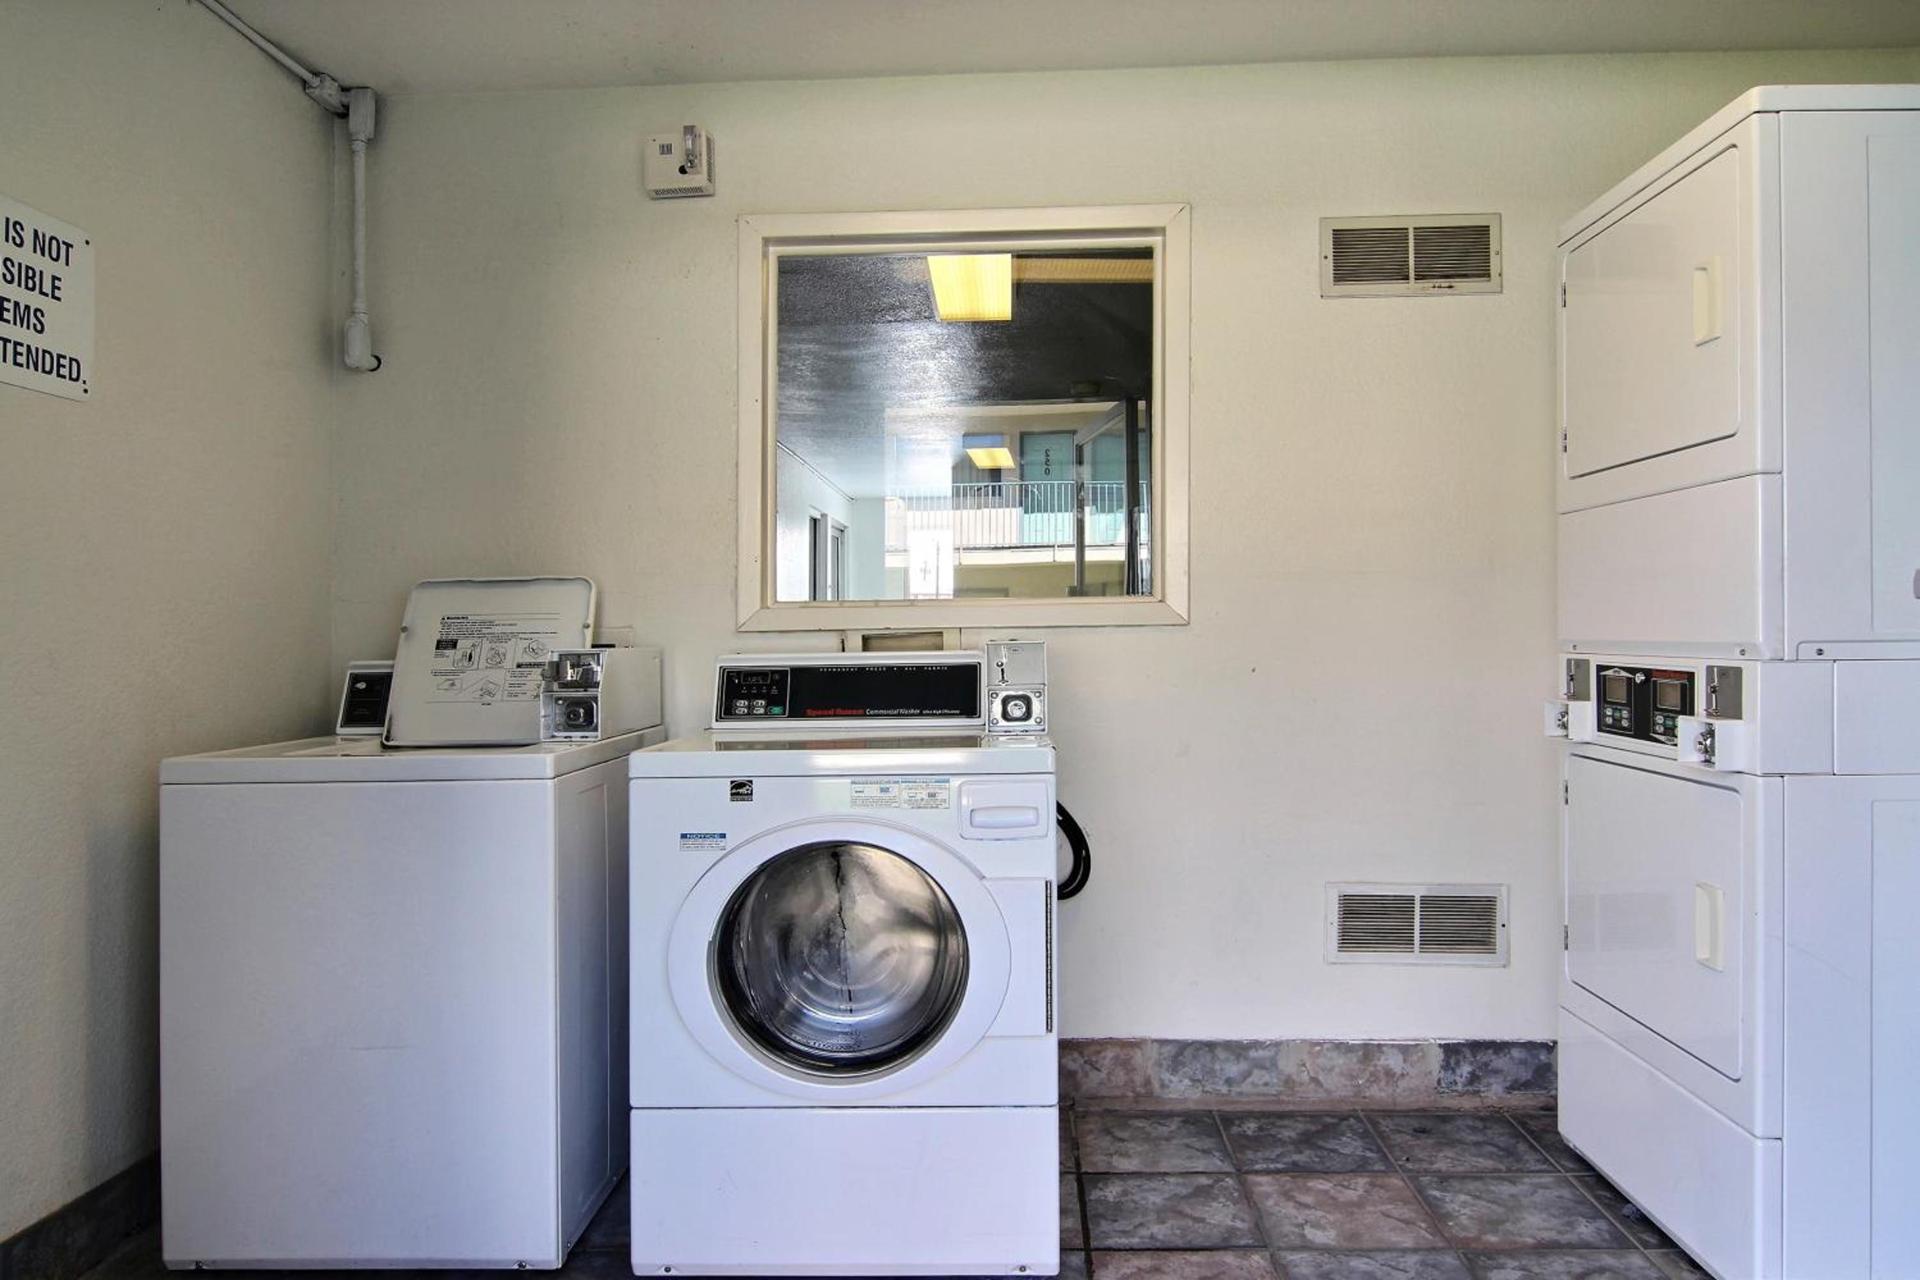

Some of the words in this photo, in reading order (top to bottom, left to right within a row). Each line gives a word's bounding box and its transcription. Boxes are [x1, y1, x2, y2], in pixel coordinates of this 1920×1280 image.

[4, 217, 25, 249] IS
[33, 228, 74, 267] NOT
[2, 257, 62, 302] SIBLE
[0, 295, 46, 335] EMS
[0, 336, 87, 385] TENDED.
